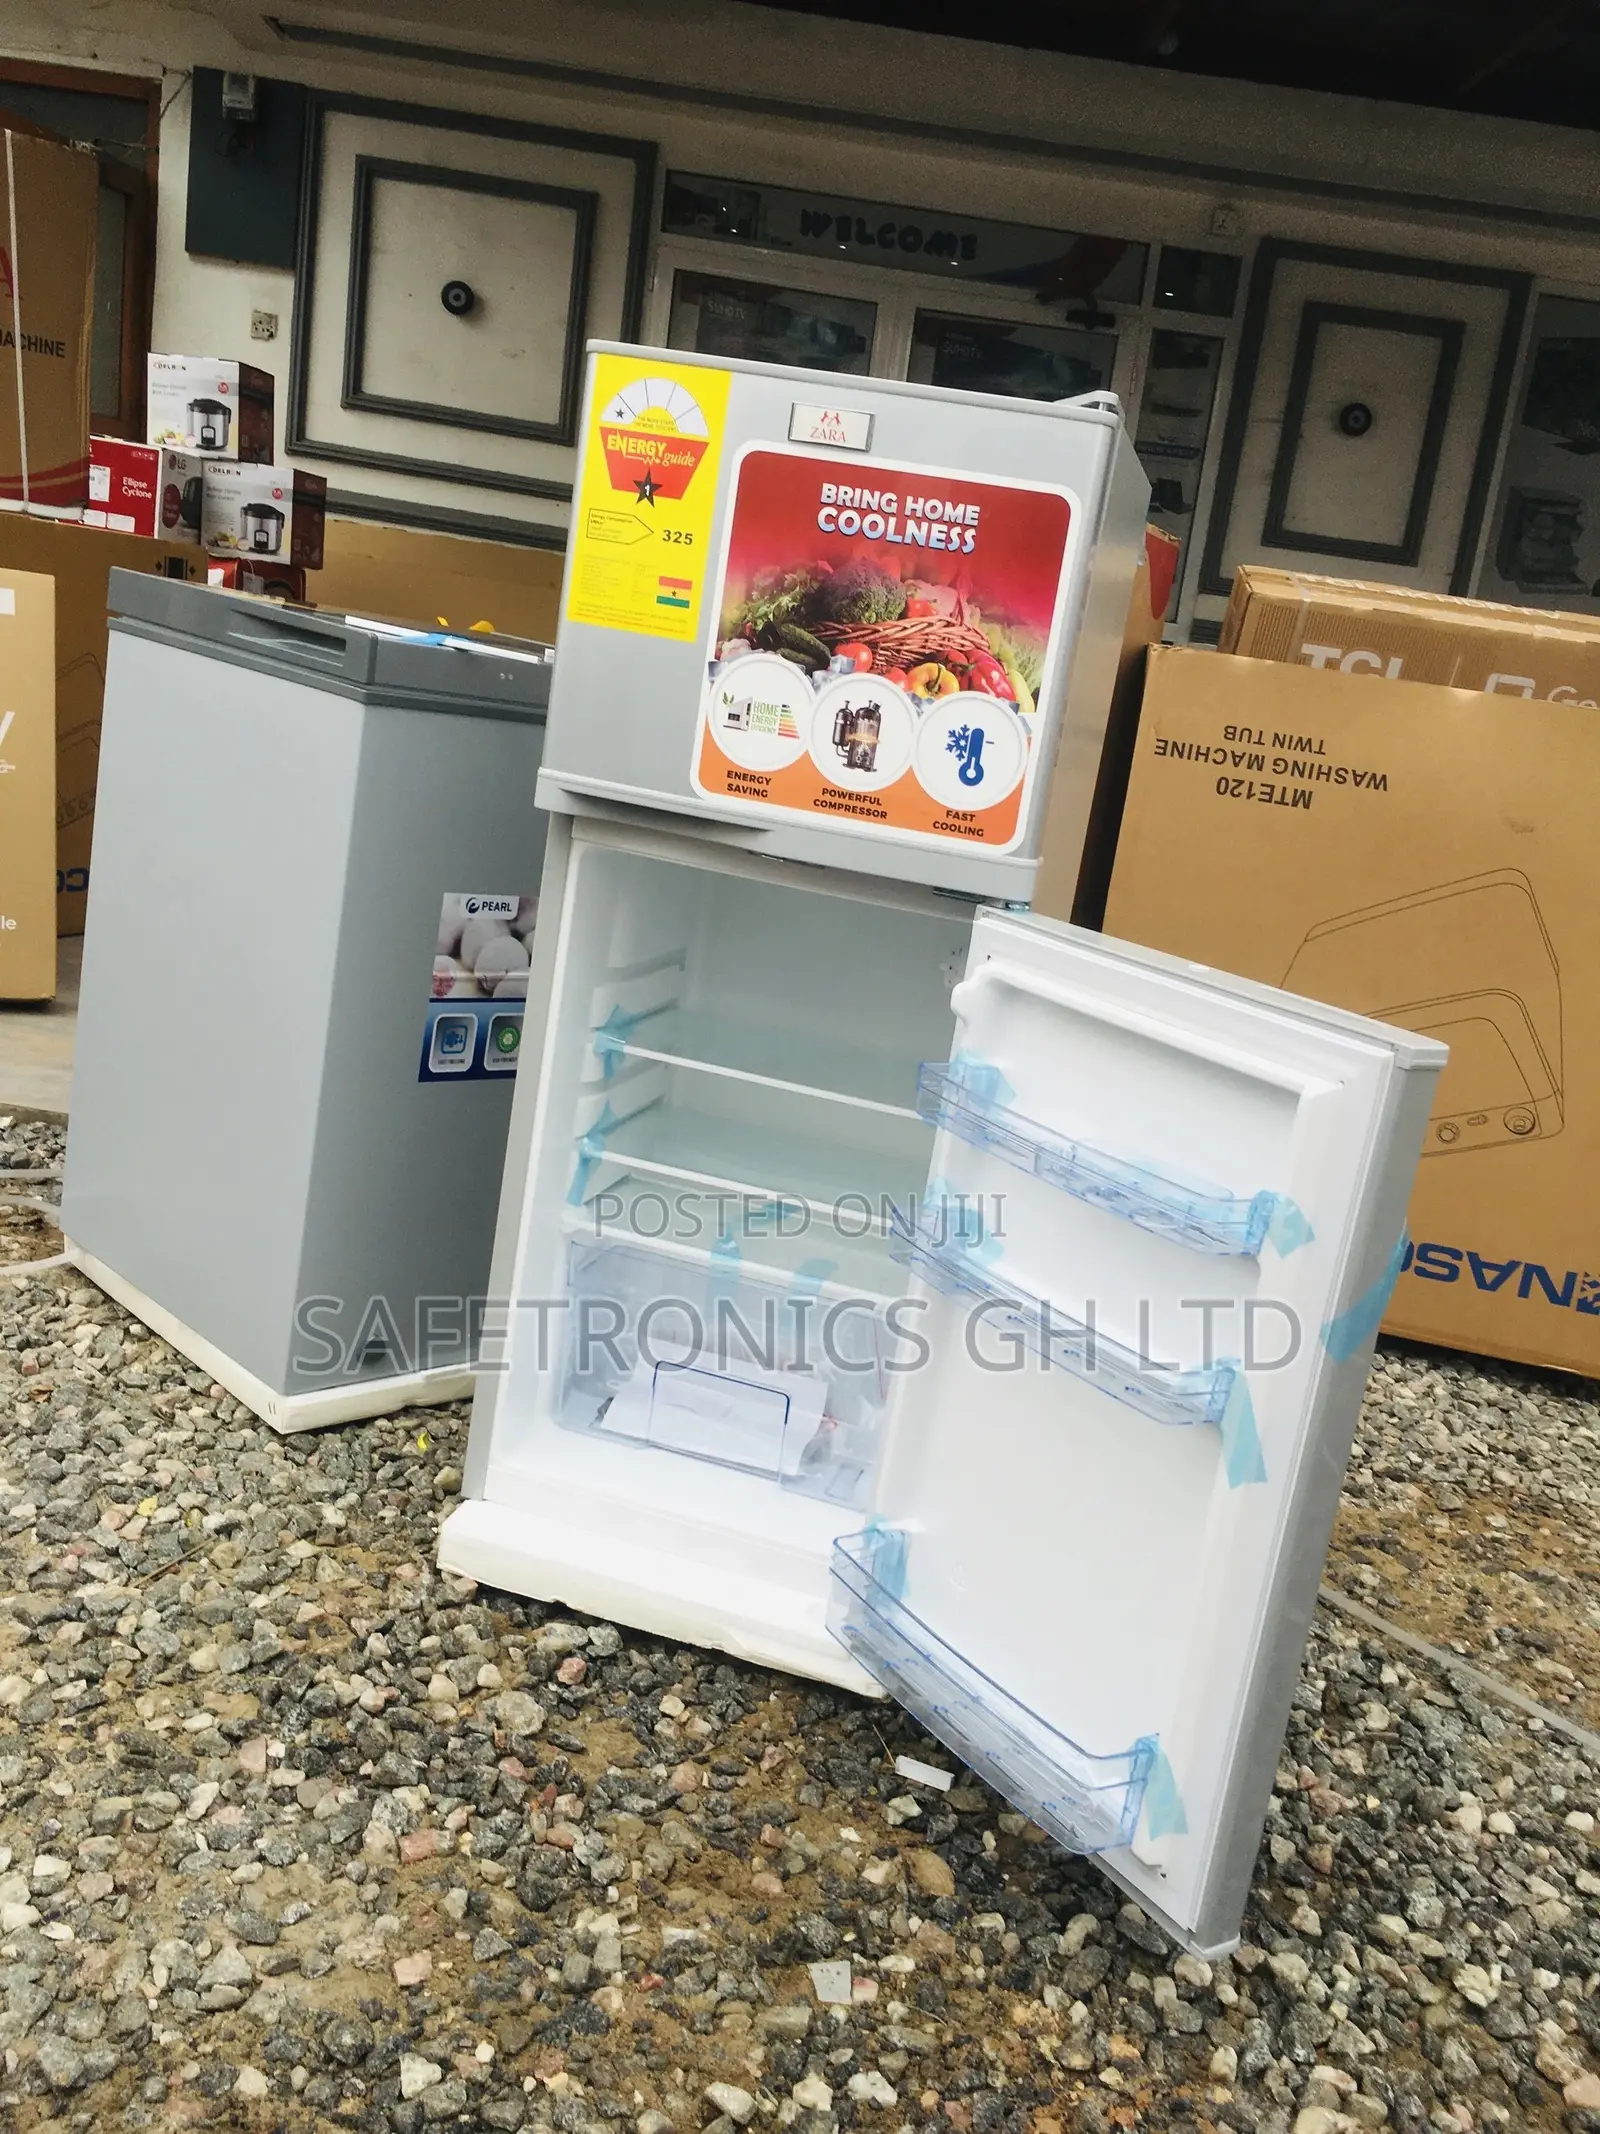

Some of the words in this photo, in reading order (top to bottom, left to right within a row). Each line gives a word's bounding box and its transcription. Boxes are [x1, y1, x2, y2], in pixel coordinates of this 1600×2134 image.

[800, 208, 978, 261] WELCOME
[0, 328, 66, 358] ACHINE
[158, 363, 187, 372] DELRN
[809, 426, 846, 443] ZARA
[607, 430, 667, 458] ENERGY
[661, 451, 695, 467] guide
[212, 465, 242, 476] DELRN
[122, 476, 148, 489] Ellipse
[644, 484, 651, 497] 1
[122, 485, 153, 499] Cyclone
[820, 482, 898, 514] BRING
[904, 495, 981, 527] HOME
[662, 530, 694, 546] 325
[816, 506, 977, 555] COOLNESS
[754, 701, 780, 717] HOME
[751, 713, 778, 726] ENERGY
[1223, 724, 1265, 746] TUB
[1273, 732, 1326, 756] TWIN
[1153, 737, 1266, 772] MACHINE
[726, 770, 772, 786] ENERGY
[1272, 757, 1389, 793] WASHING
[726, 783, 769, 798] SAVING
[821, 787, 883, 807] POWERFUL
[1215, 776, 1314, 811] MTE120
[813, 798, 888, 820] COMPRESSOR
[945, 809, 976, 823] FAST
[932, 820, 984, 838] COOLING
[481, 901, 513, 913] PEARL
[1398, 1240, 1578, 1308] NAS
